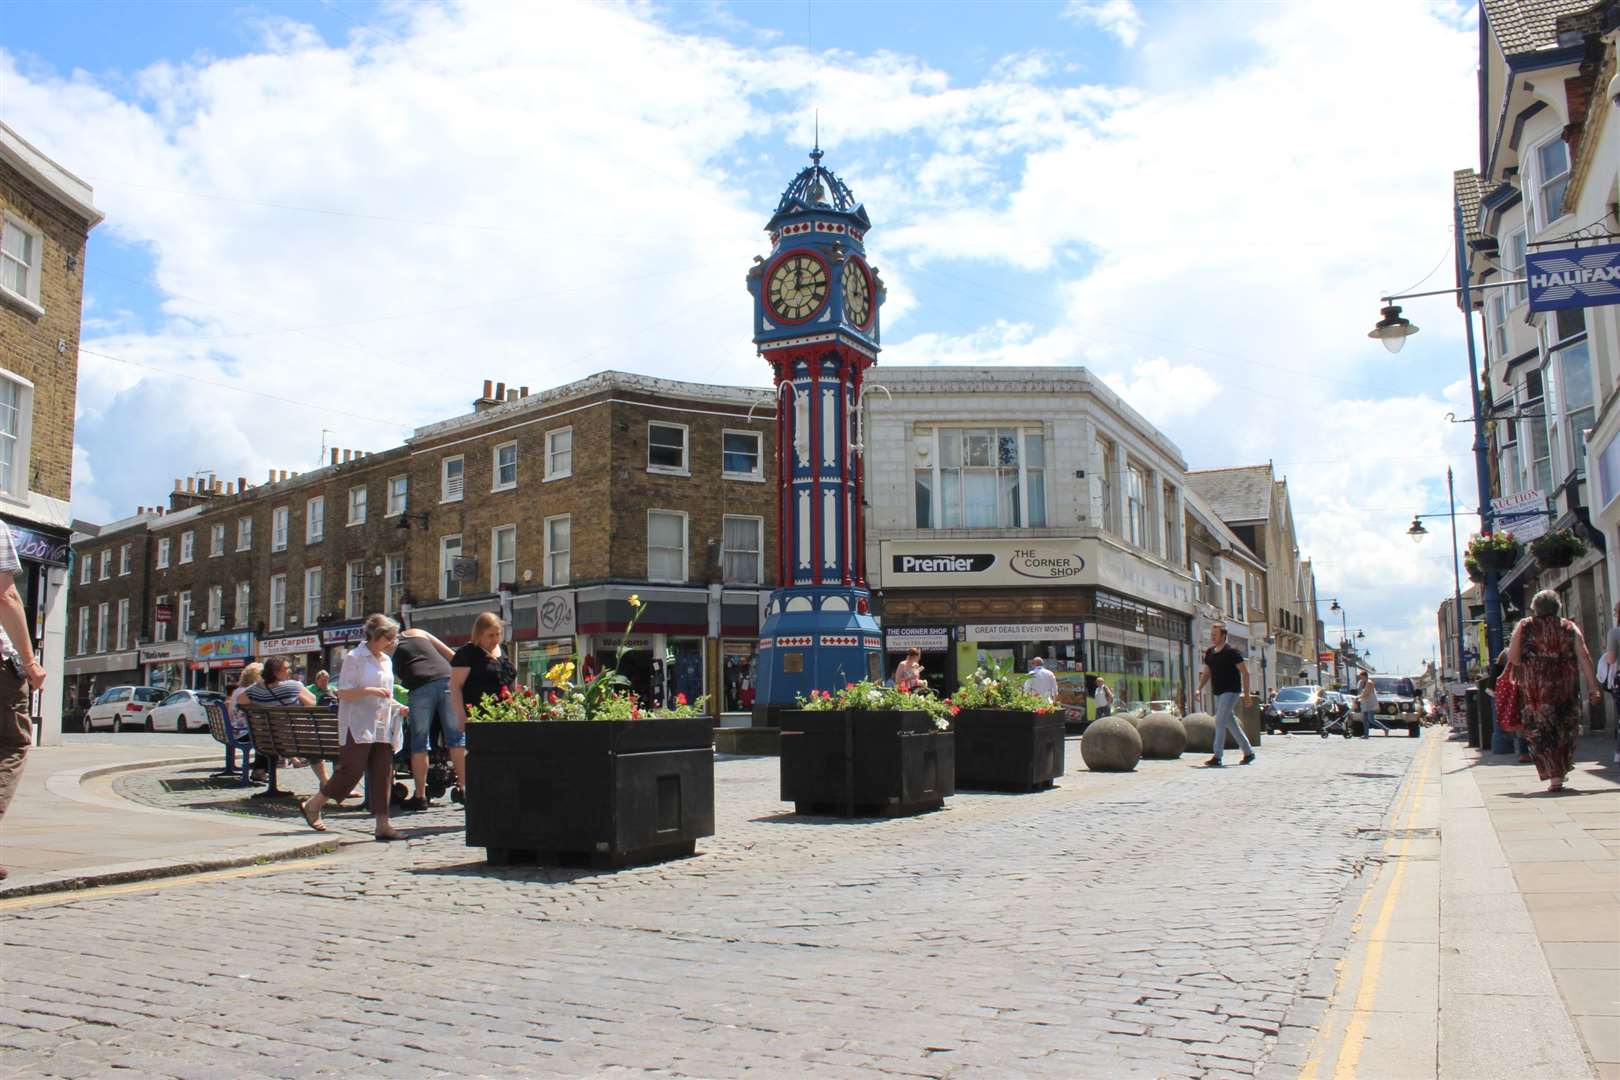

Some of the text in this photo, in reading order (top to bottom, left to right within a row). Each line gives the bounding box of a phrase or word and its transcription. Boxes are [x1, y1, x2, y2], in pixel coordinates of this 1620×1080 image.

[1531, 265, 1620, 289] HALIFAX
[1493, 490, 1538, 510] AUCTION
[1014, 549, 1036, 558] THE
[902, 555, 974, 572] Premier
[1024, 558, 1070, 568] CORNER
[1050, 567, 1080, 576] SHOP
[281, 636, 316, 646] Carpets
